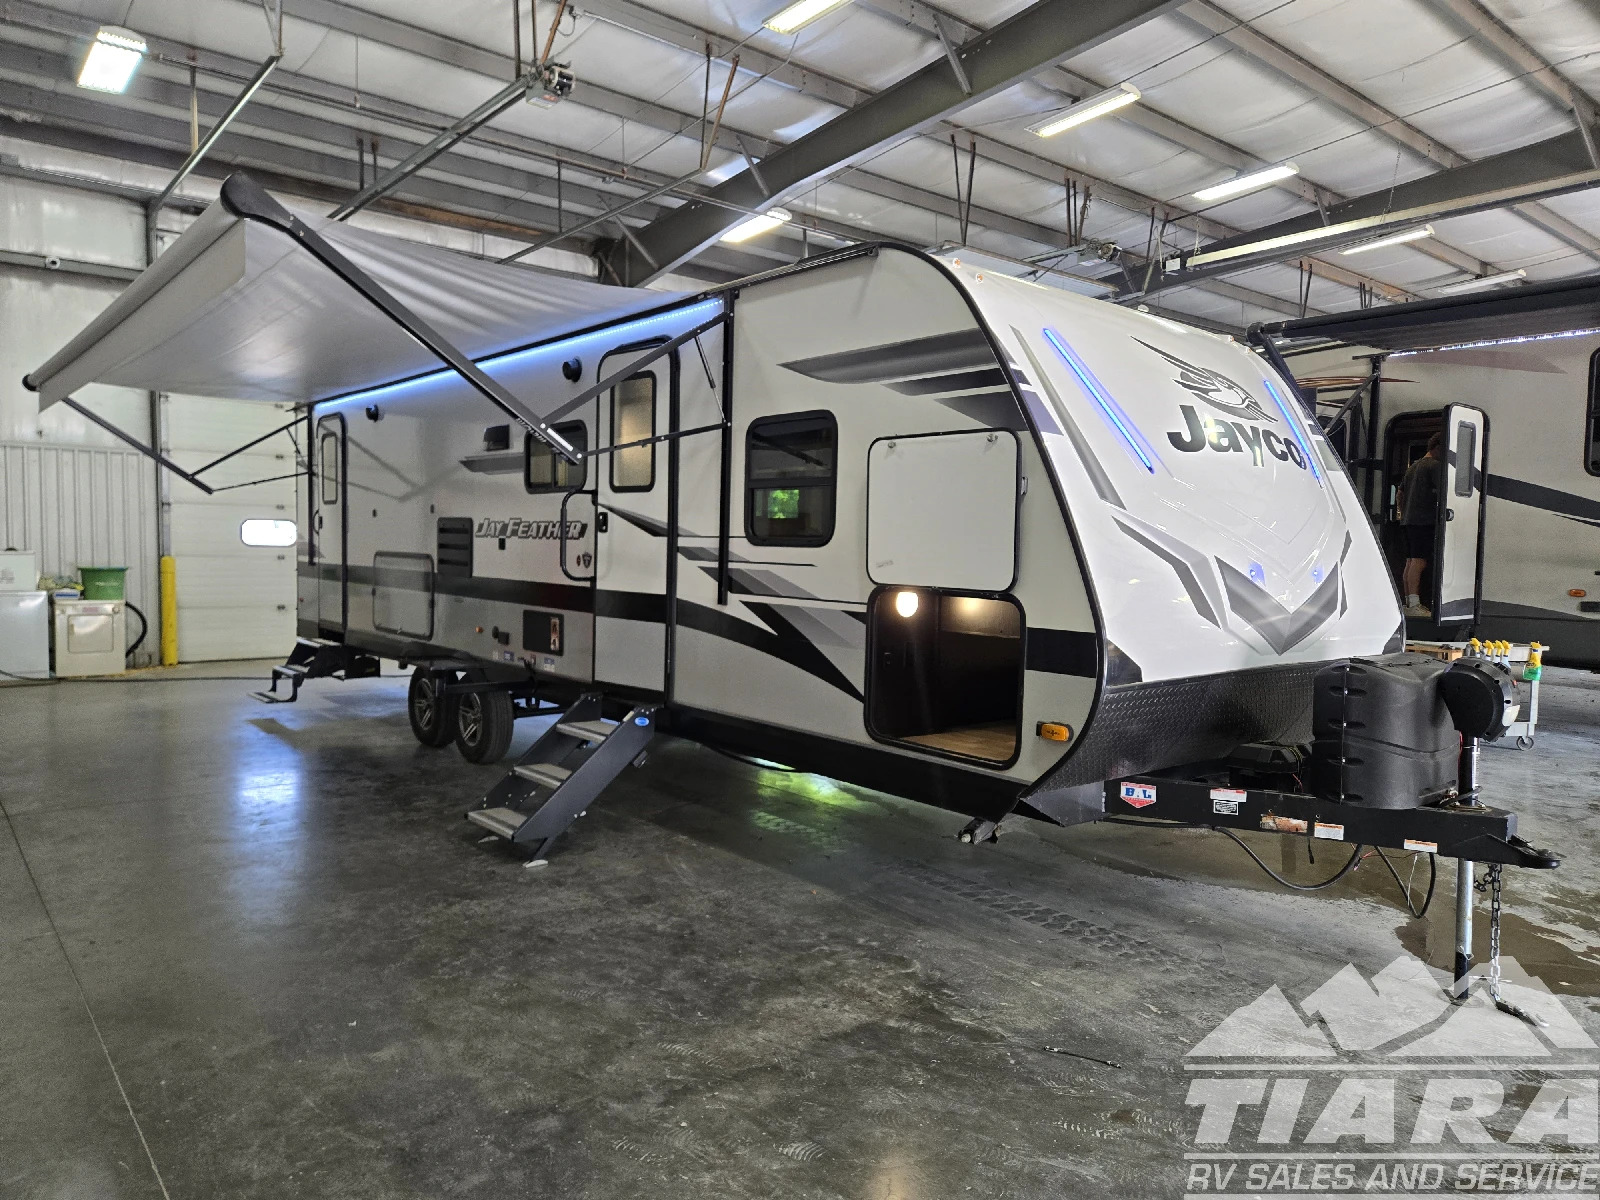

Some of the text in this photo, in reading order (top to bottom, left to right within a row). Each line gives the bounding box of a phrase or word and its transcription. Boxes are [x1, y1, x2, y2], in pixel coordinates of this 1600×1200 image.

[1166, 404, 1307, 471] Jayco
[475, 517, 505, 539] JAY
[1124, 786, 1153, 800] BL
